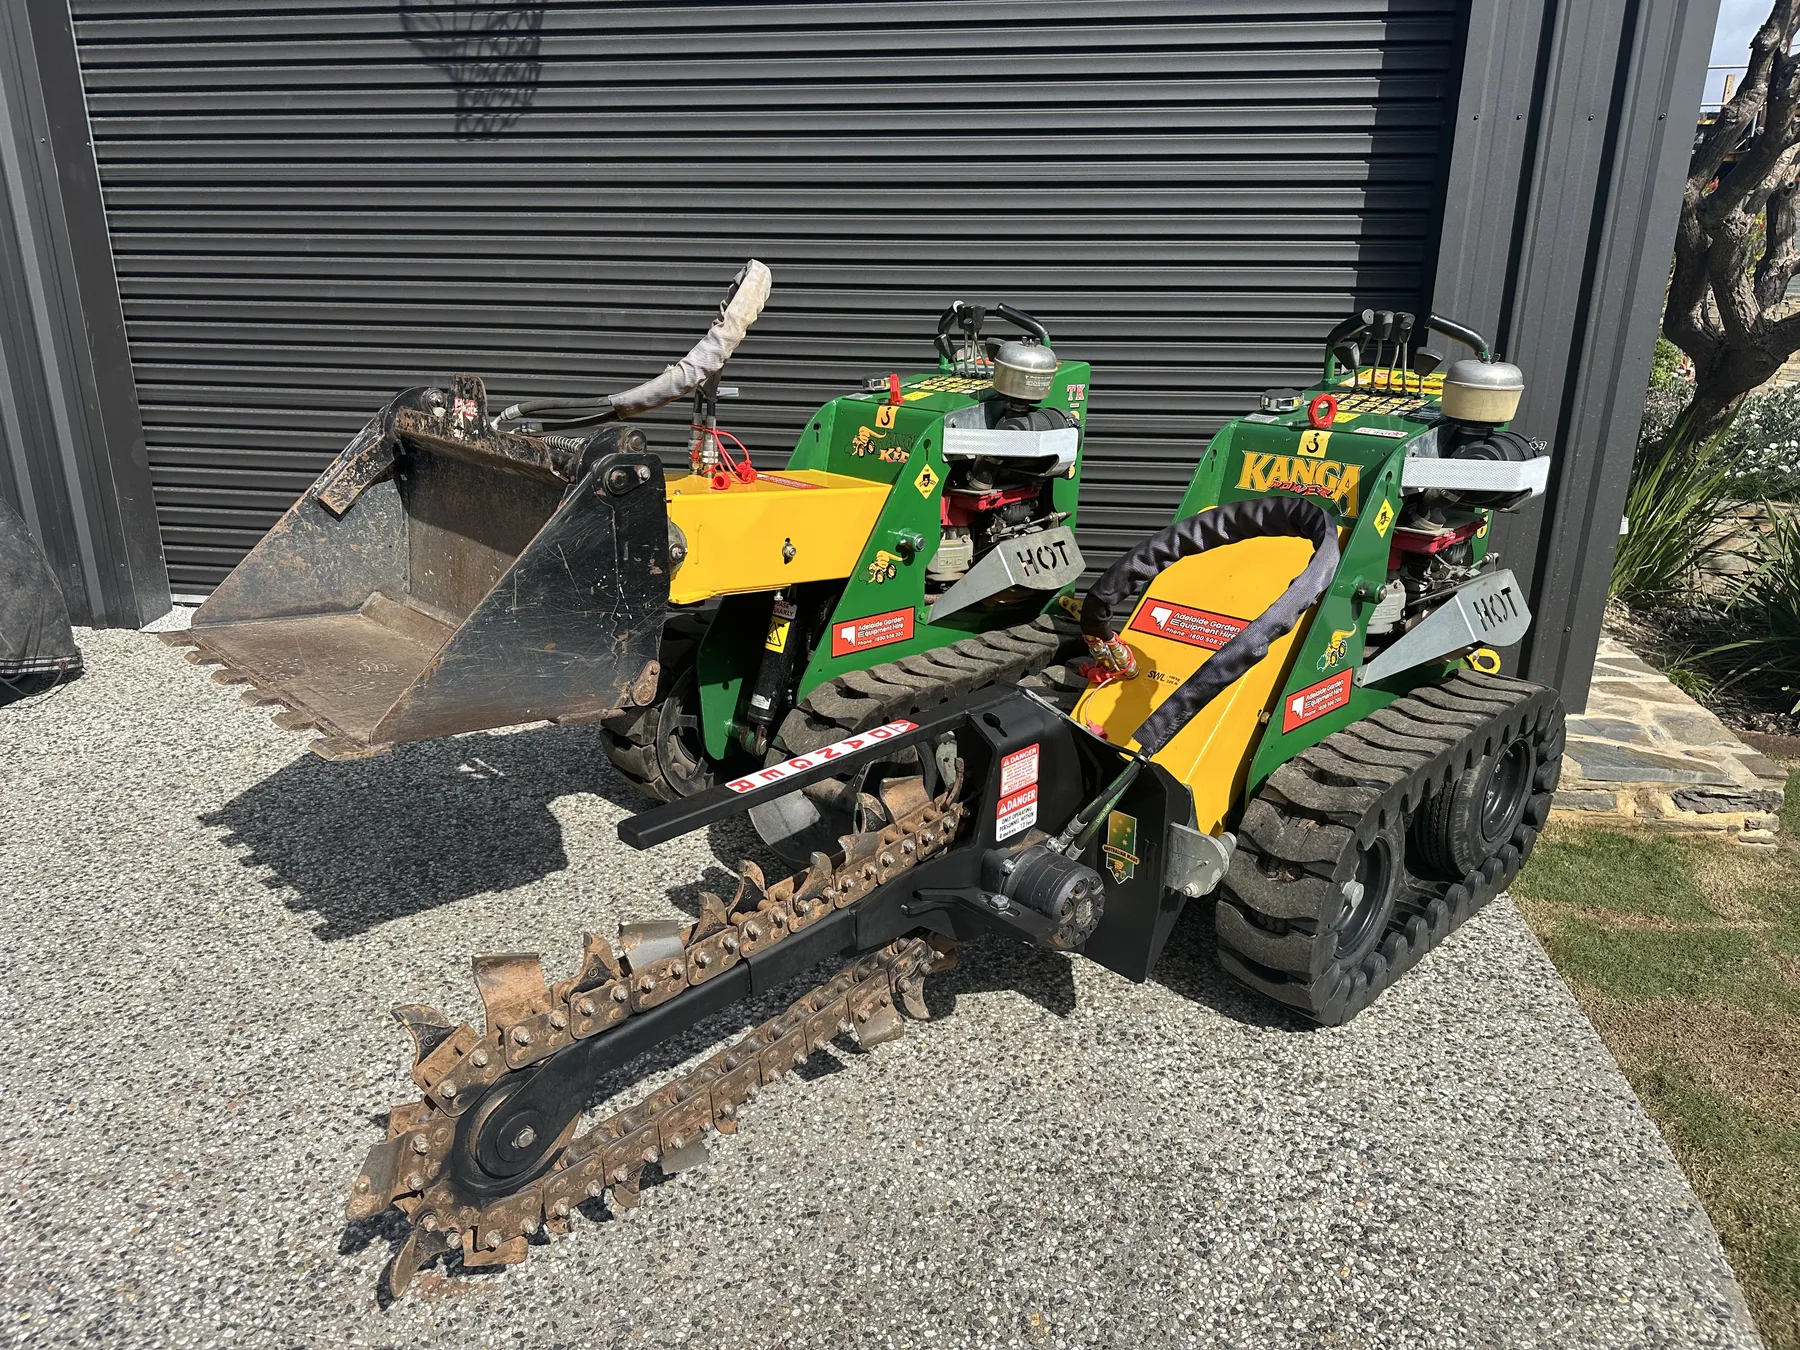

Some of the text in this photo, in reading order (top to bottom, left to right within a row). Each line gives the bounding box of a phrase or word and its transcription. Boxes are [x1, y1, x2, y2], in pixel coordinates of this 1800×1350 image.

[1066, 384, 1086, 401] TK
[1234, 450, 1364, 519] KANGA
[1268, 480, 1335, 499] POWER
[1016, 540, 1069, 576] HOT
[1473, 587, 1518, 632] HOT
[858, 616, 904, 632] Adelaide Garden
[858, 622, 904, 638] Equipment Hire
[1170, 618, 1218, 636] Equipment
[1174, 612, 1241, 633] Adelaide Garden
[1165, 628, 1185, 636] Phone
[1148, 670, 1165, 682] SWL
[1306, 680, 1344, 701] Adelaide Garden
[728, 728, 892, 792] DANGER
[1010, 748, 1036, 764] DANGER
[1007, 789, 1036, 811] DANGER
[1002, 806, 1032, 824] ONLY OPERATING
[1000, 820, 1020, 832] PERSONNEL
